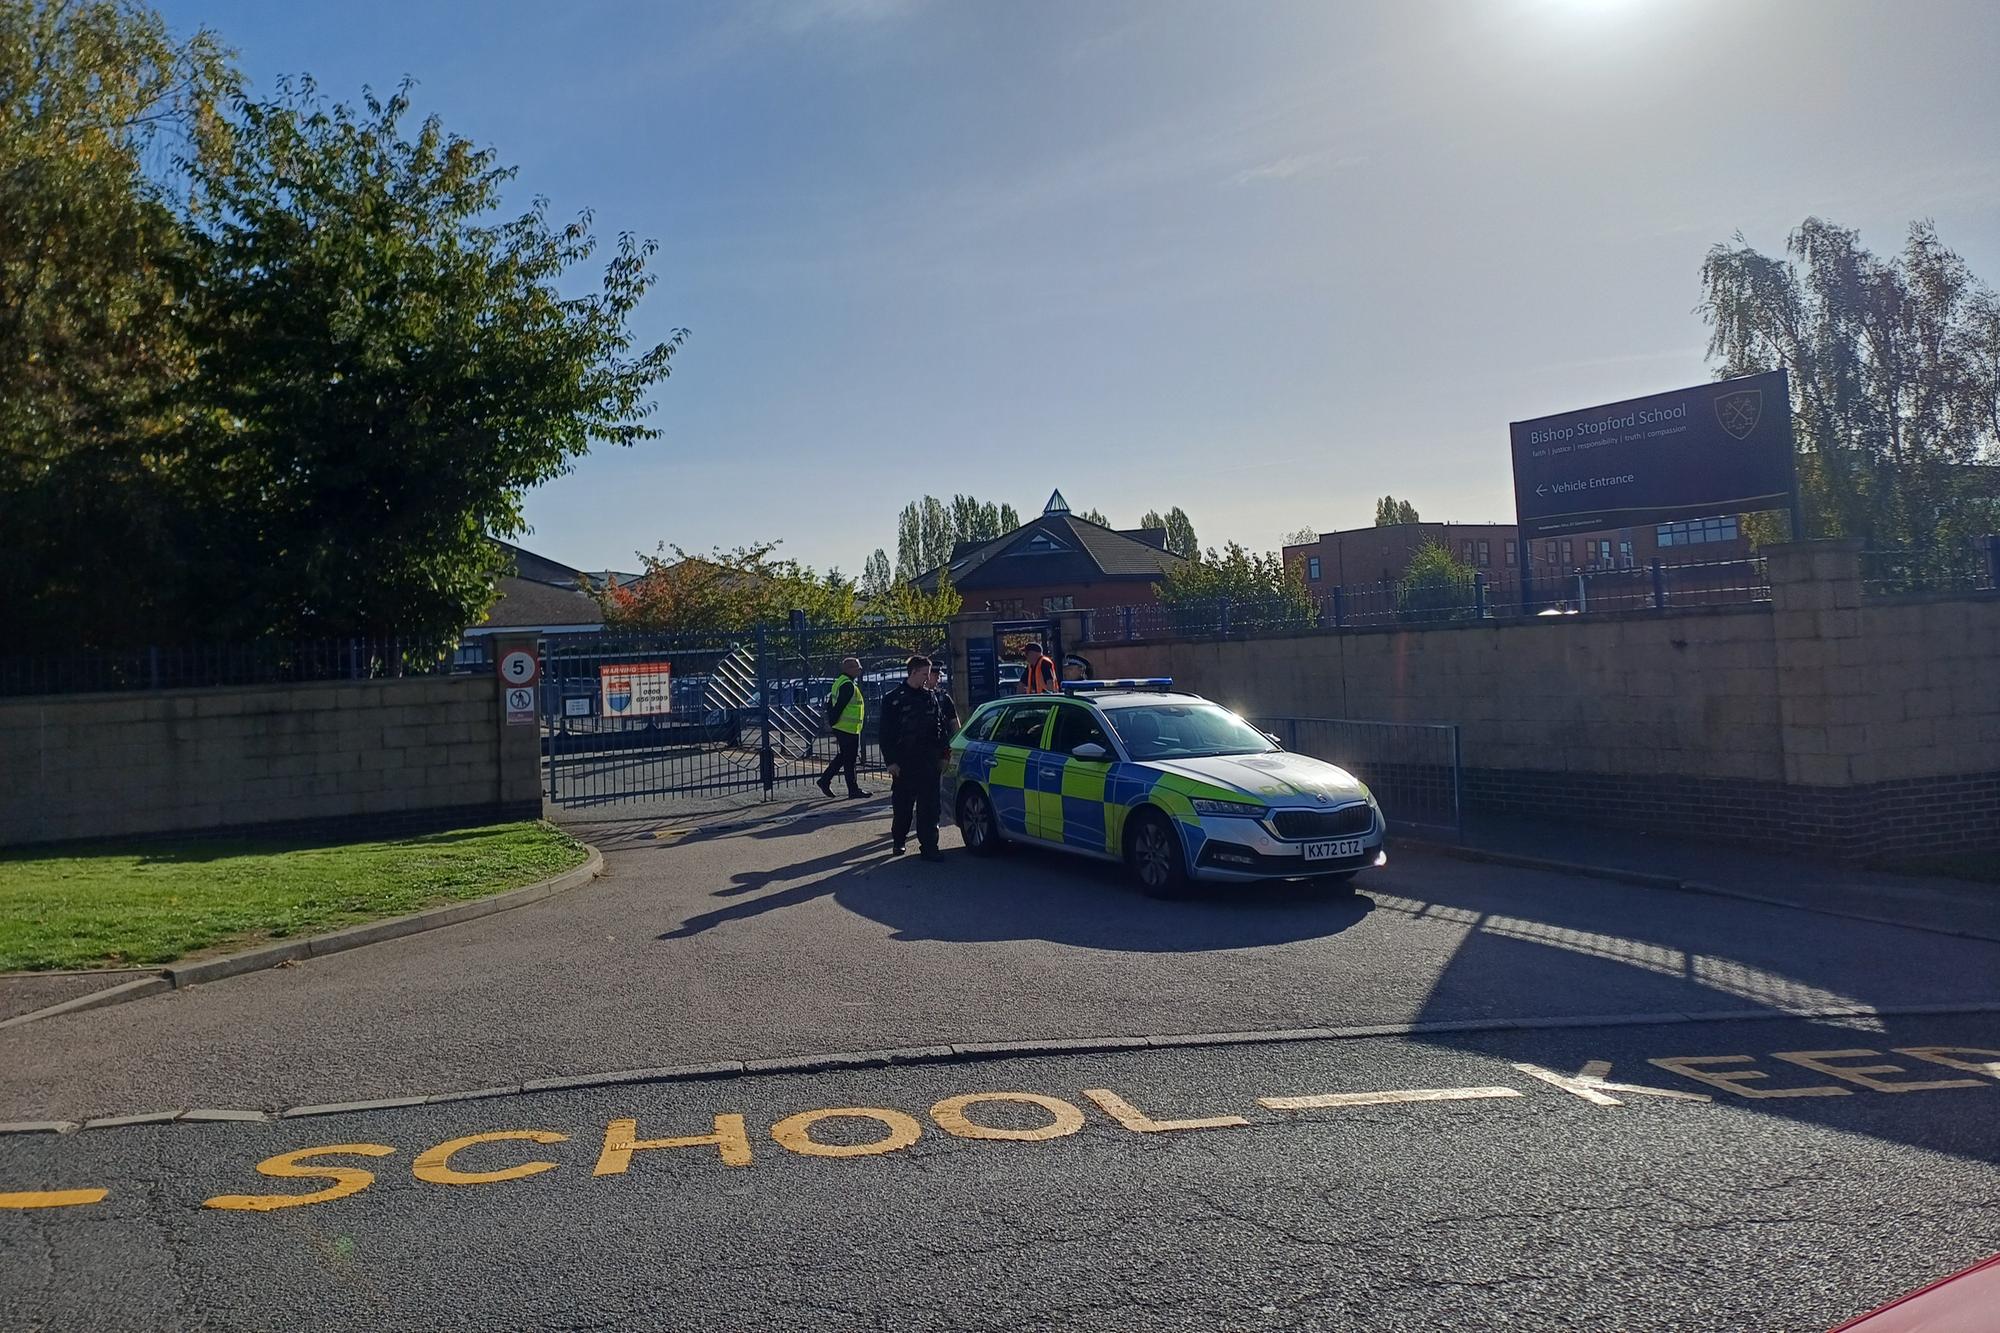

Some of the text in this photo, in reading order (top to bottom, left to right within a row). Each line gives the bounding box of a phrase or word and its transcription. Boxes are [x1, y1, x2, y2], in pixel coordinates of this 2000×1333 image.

[1531, 403, 1686, 444] Bishop Stopford School
[1577, 436, 1618, 450] responsibility
[1624, 432, 1641, 442] truth
[1647, 425, 1687, 438] compassion
[1552, 474, 1634, 494] Vehicle Entrance
[512, 660, 525, 676] 5
[1308, 841, 1360, 857] KX72 CTZ
[201, 1087, 1249, 1212] SCHOOL
